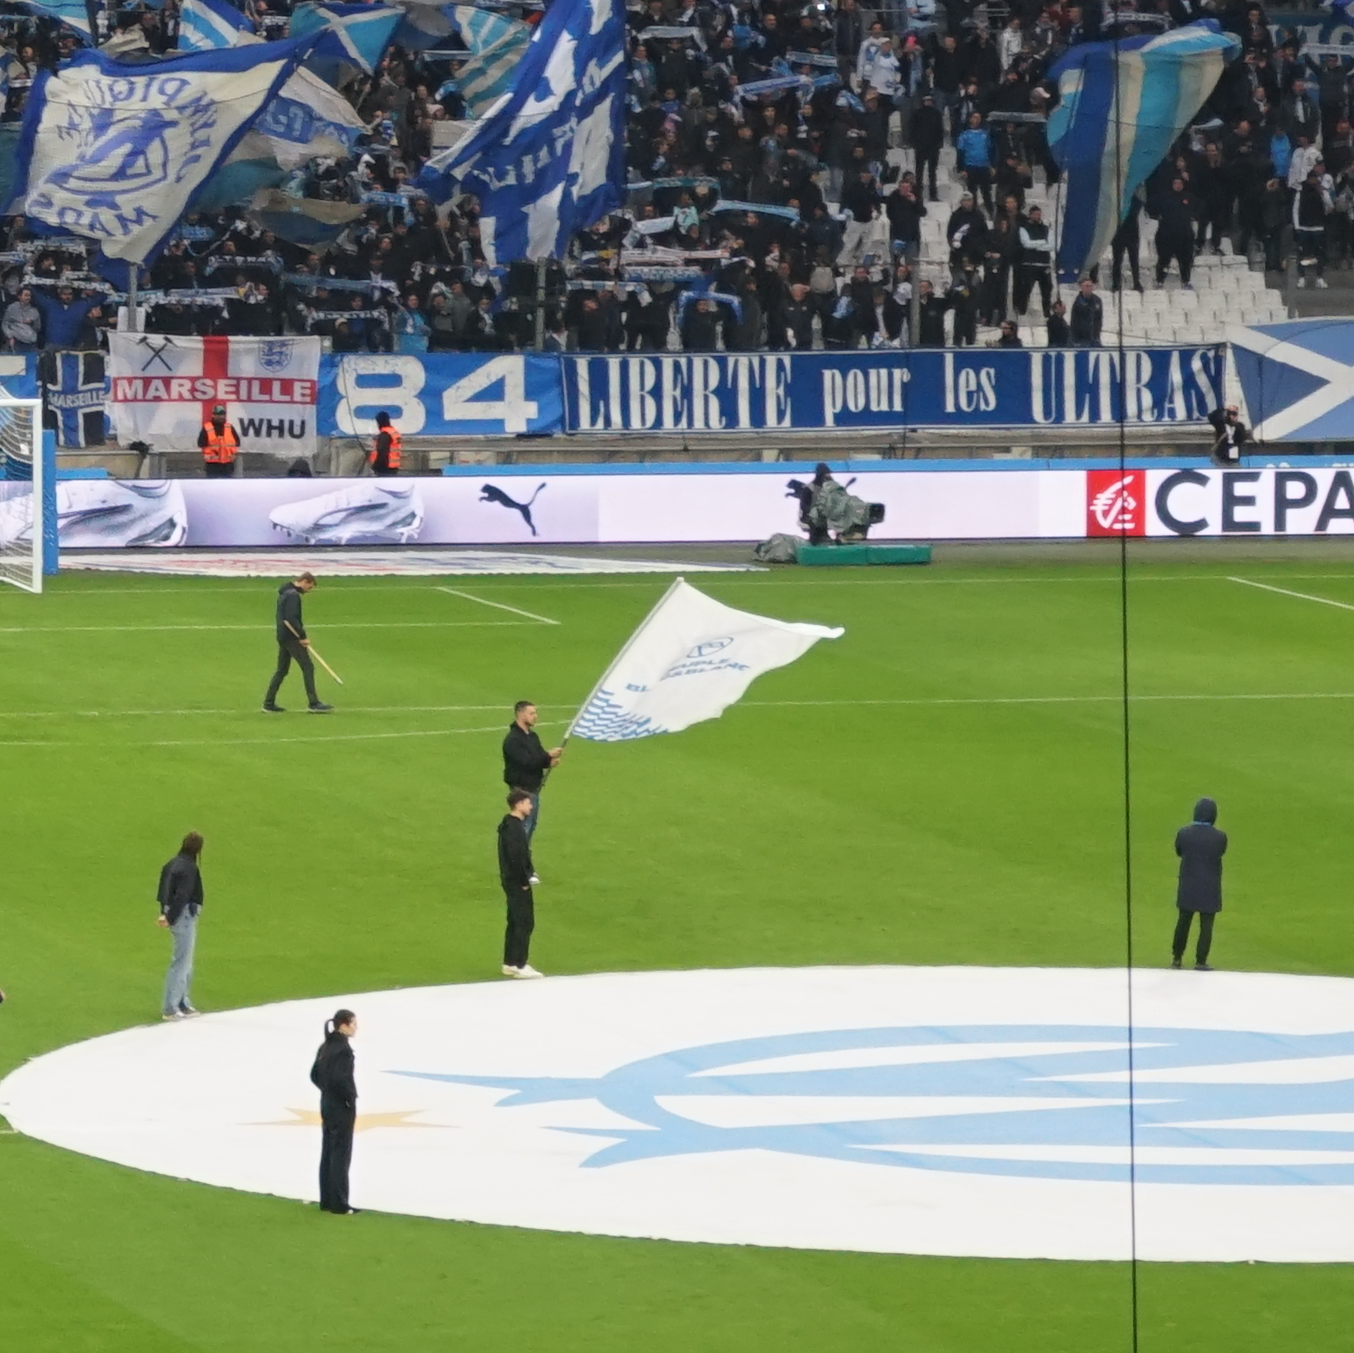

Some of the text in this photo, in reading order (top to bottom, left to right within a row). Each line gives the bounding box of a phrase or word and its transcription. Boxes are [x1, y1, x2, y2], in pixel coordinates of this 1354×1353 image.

[49, 389, 106, 411] MARSEILLE
[115, 377, 312, 404] MARSEILLE
[334, 354, 541, 435] 84
[577, 348, 1219, 431] LIBERTE pour les ULTRAS
[239, 417, 307, 440] WHU
[1154, 471, 1354, 536] CEPA
